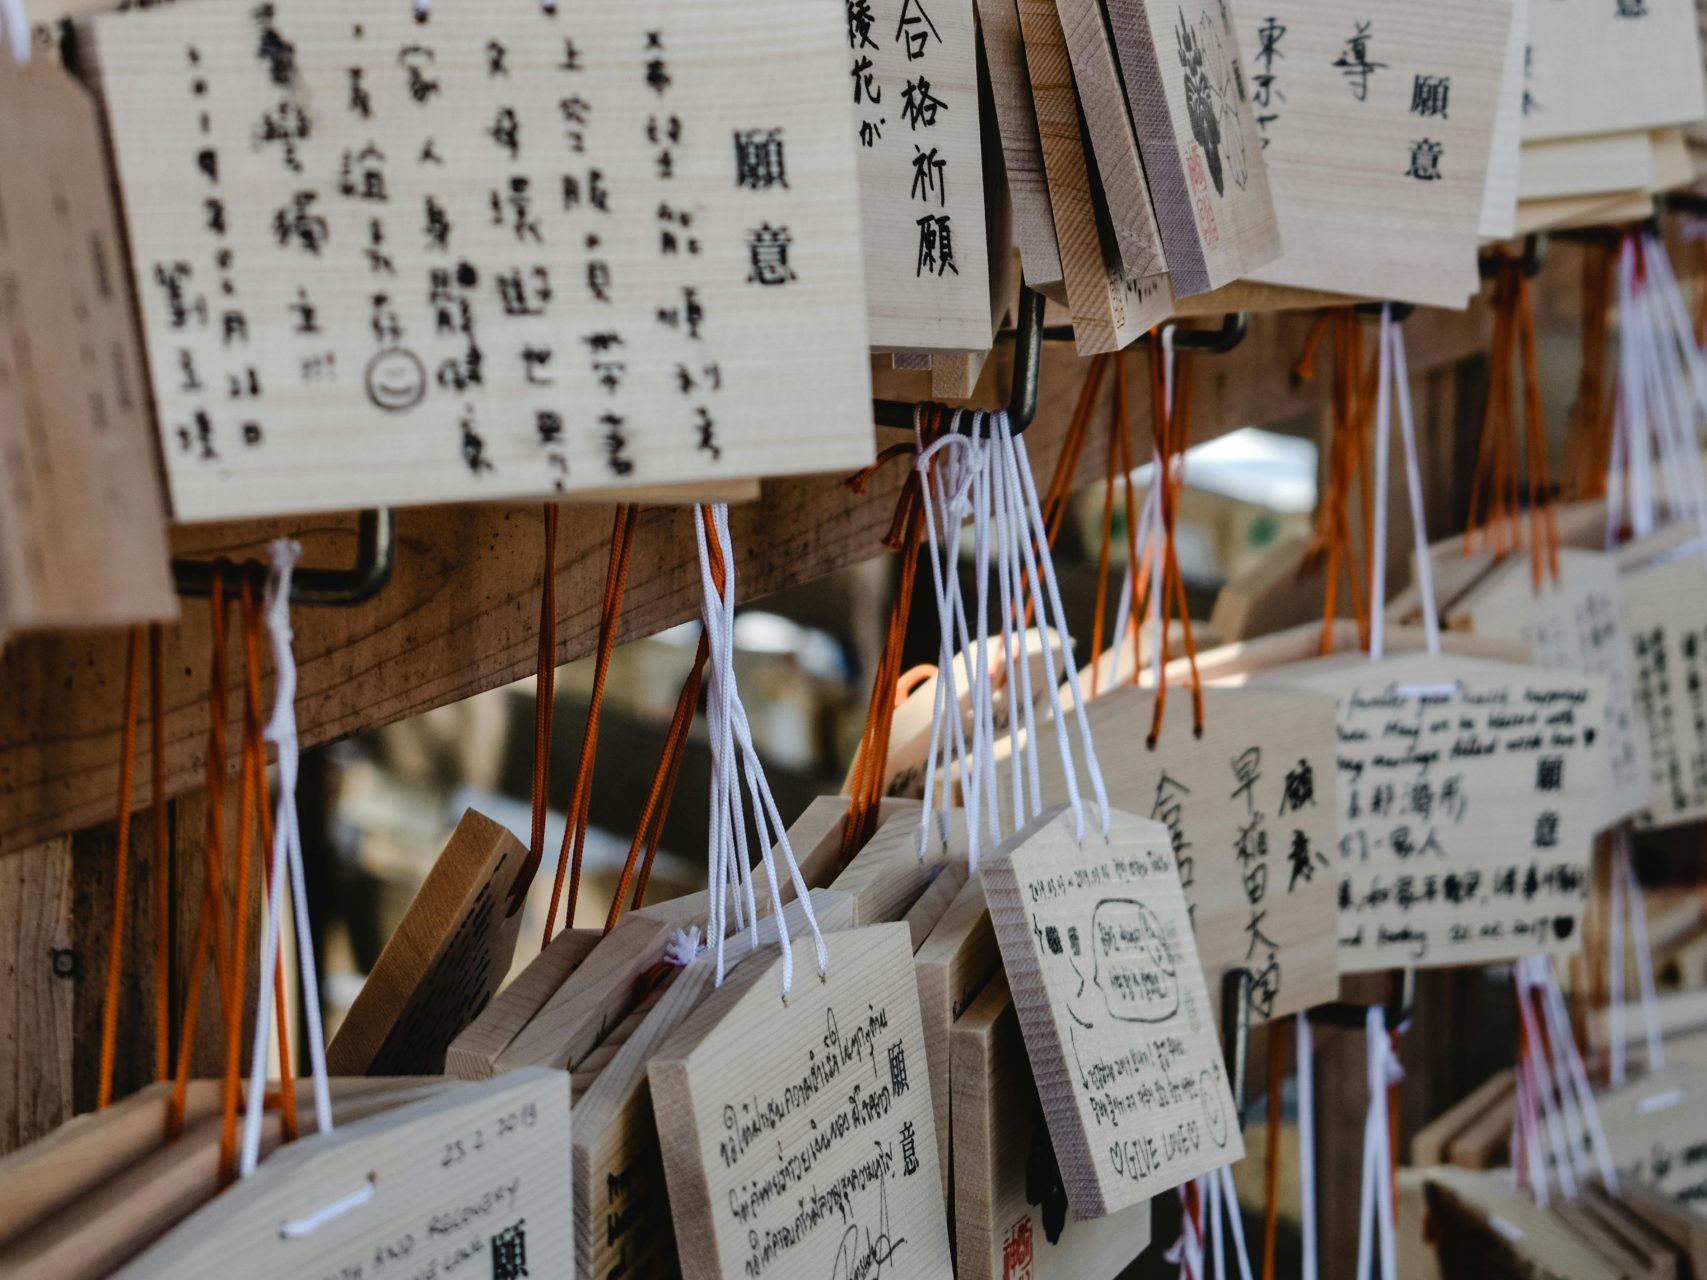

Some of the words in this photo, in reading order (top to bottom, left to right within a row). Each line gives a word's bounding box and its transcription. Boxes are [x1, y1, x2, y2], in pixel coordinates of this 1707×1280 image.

[1331, 20, 1389, 103] 導
[1404, 74, 1451, 182] 願意
[732, 126, 797, 286] 願意
[887, 1038, 920, 1177] 願意
[1124, 1135, 1160, 1182] GIVE
